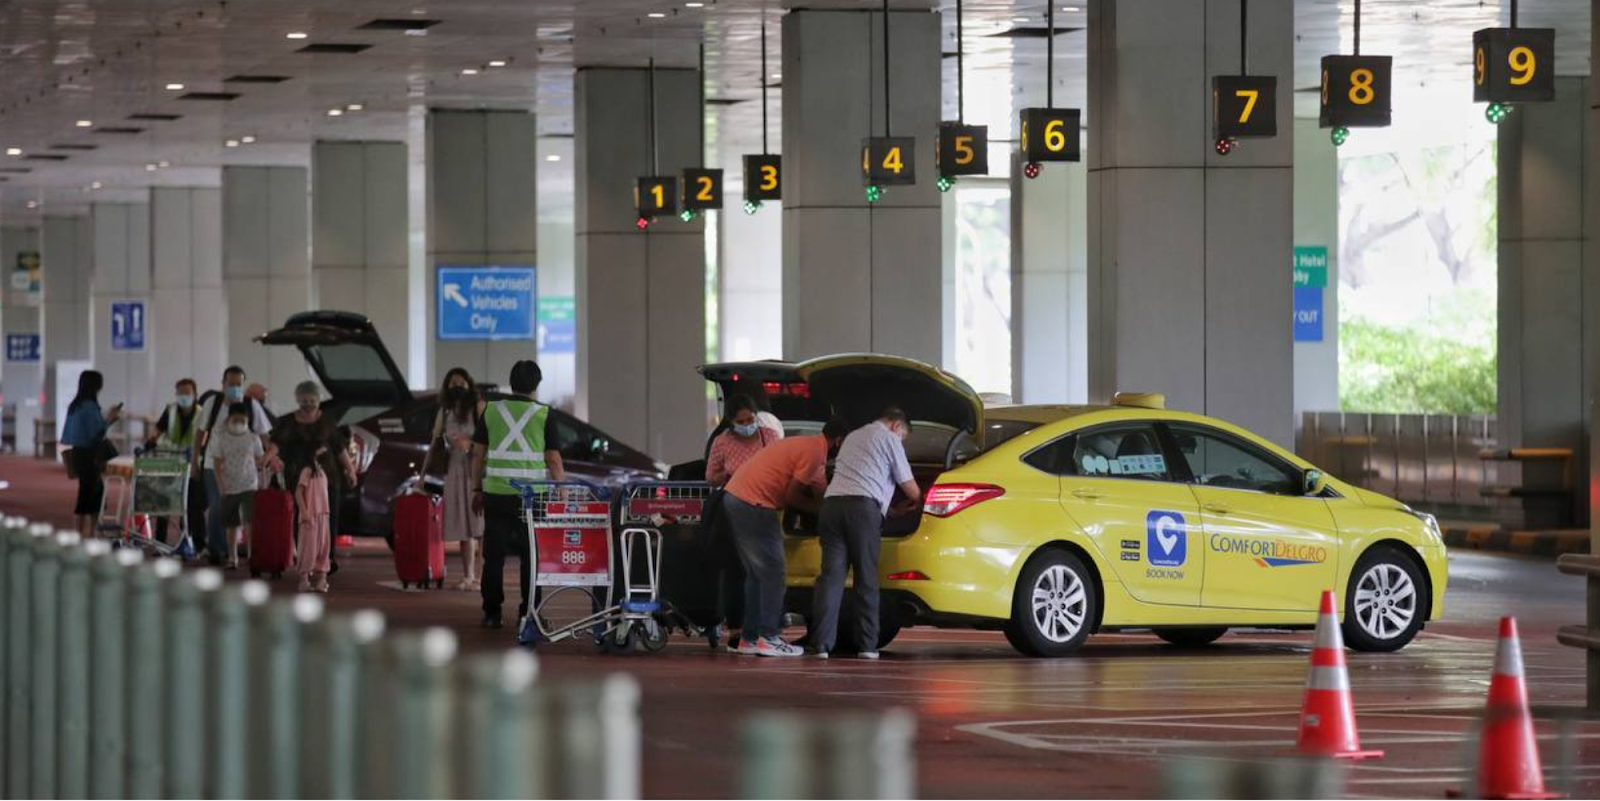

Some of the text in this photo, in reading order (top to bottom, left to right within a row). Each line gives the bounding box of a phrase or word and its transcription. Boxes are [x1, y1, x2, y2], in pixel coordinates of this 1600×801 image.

[1507, 46, 1537, 86] 9
[1348, 68, 1375, 106] 8
[1235, 90, 1259, 124] 7
[1044, 119, 1066, 152] 6
[882, 146, 904, 174] 4
[955, 136, 974, 165] 5
[696, 175, 713, 201] 2
[760, 164, 778, 191] 3
[651, 184, 664, 208] 1
[1300, 255, 1326, 268] Hotel
[470, 275, 532, 291] Authorised
[470, 295, 518, 310] Vehicles
[471, 313, 498, 333] Only
[1298, 311, 1318, 323] OUT
[562, 551, 585, 564] 888
[1146, 568, 1185, 580] BOOK NOW
